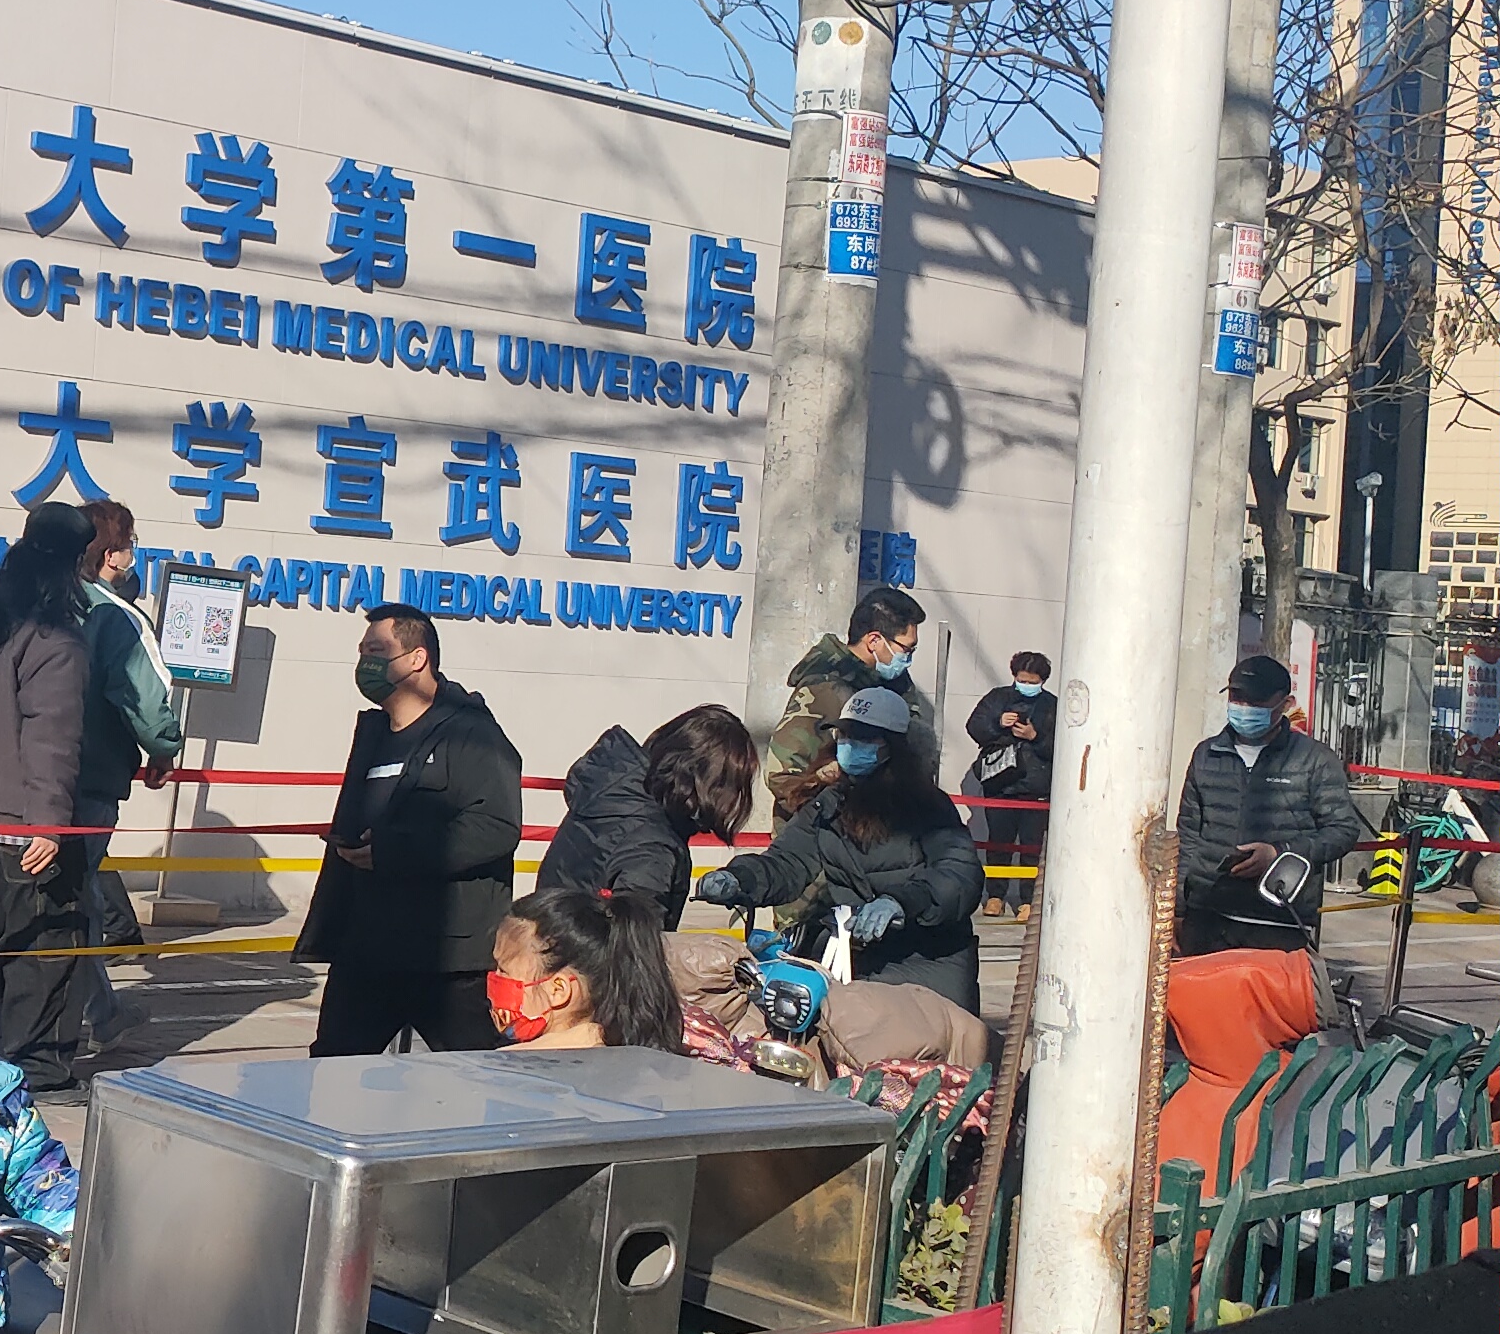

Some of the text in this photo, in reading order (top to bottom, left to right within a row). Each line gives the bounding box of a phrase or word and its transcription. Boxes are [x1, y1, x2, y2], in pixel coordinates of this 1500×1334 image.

[847, 234, 880, 255] 东岗
[3, 259, 83, 321] OF
[95, 272, 260, 349] HEBEI
[272, 300, 486, 380] MEDICAL
[498, 335, 749, 417] UNIVERSITY
[236, 554, 386, 615] CAPITAL
[400, 567, 551, 628] MEDICAL
[556, 581, 742, 640] UNIVERSITY
